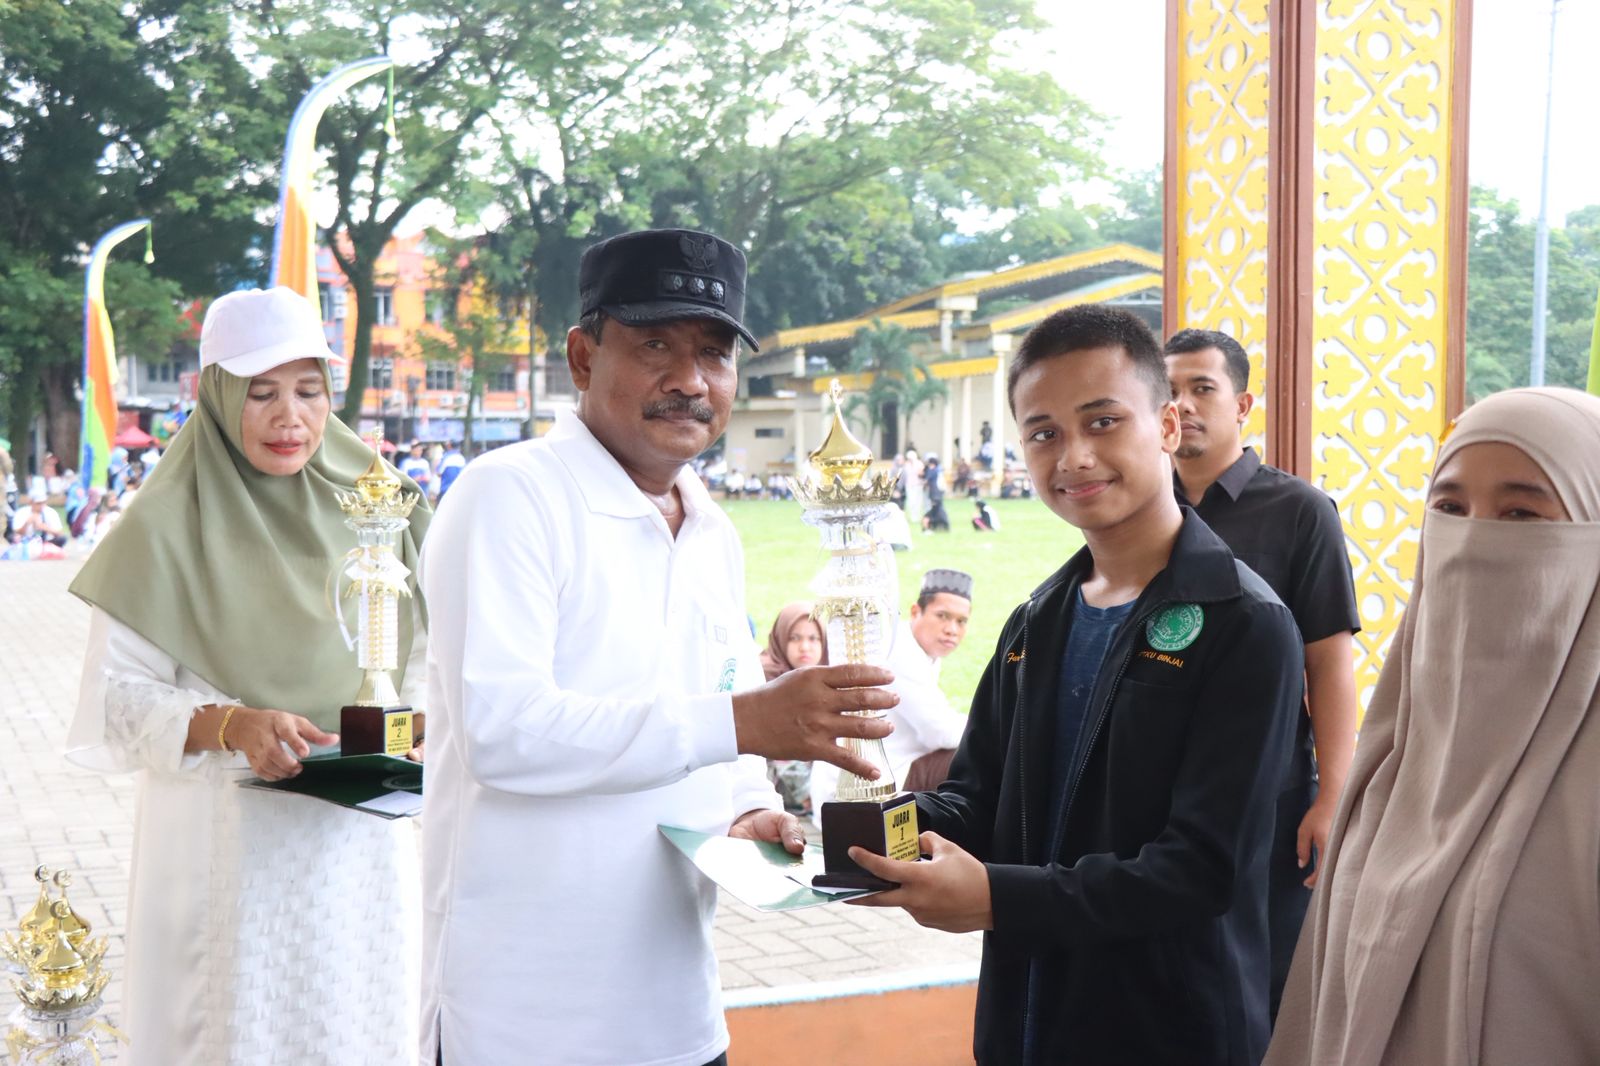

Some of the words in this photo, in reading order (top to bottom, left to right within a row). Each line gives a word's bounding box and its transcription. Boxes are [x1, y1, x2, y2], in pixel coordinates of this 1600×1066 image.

[1157, 654, 1184, 668] BINJAI
[392, 716, 406, 728] JUARA
[396, 727, 401, 738] 2
[892, 809, 910, 828] JUARA
[900, 826, 904, 841] 1
